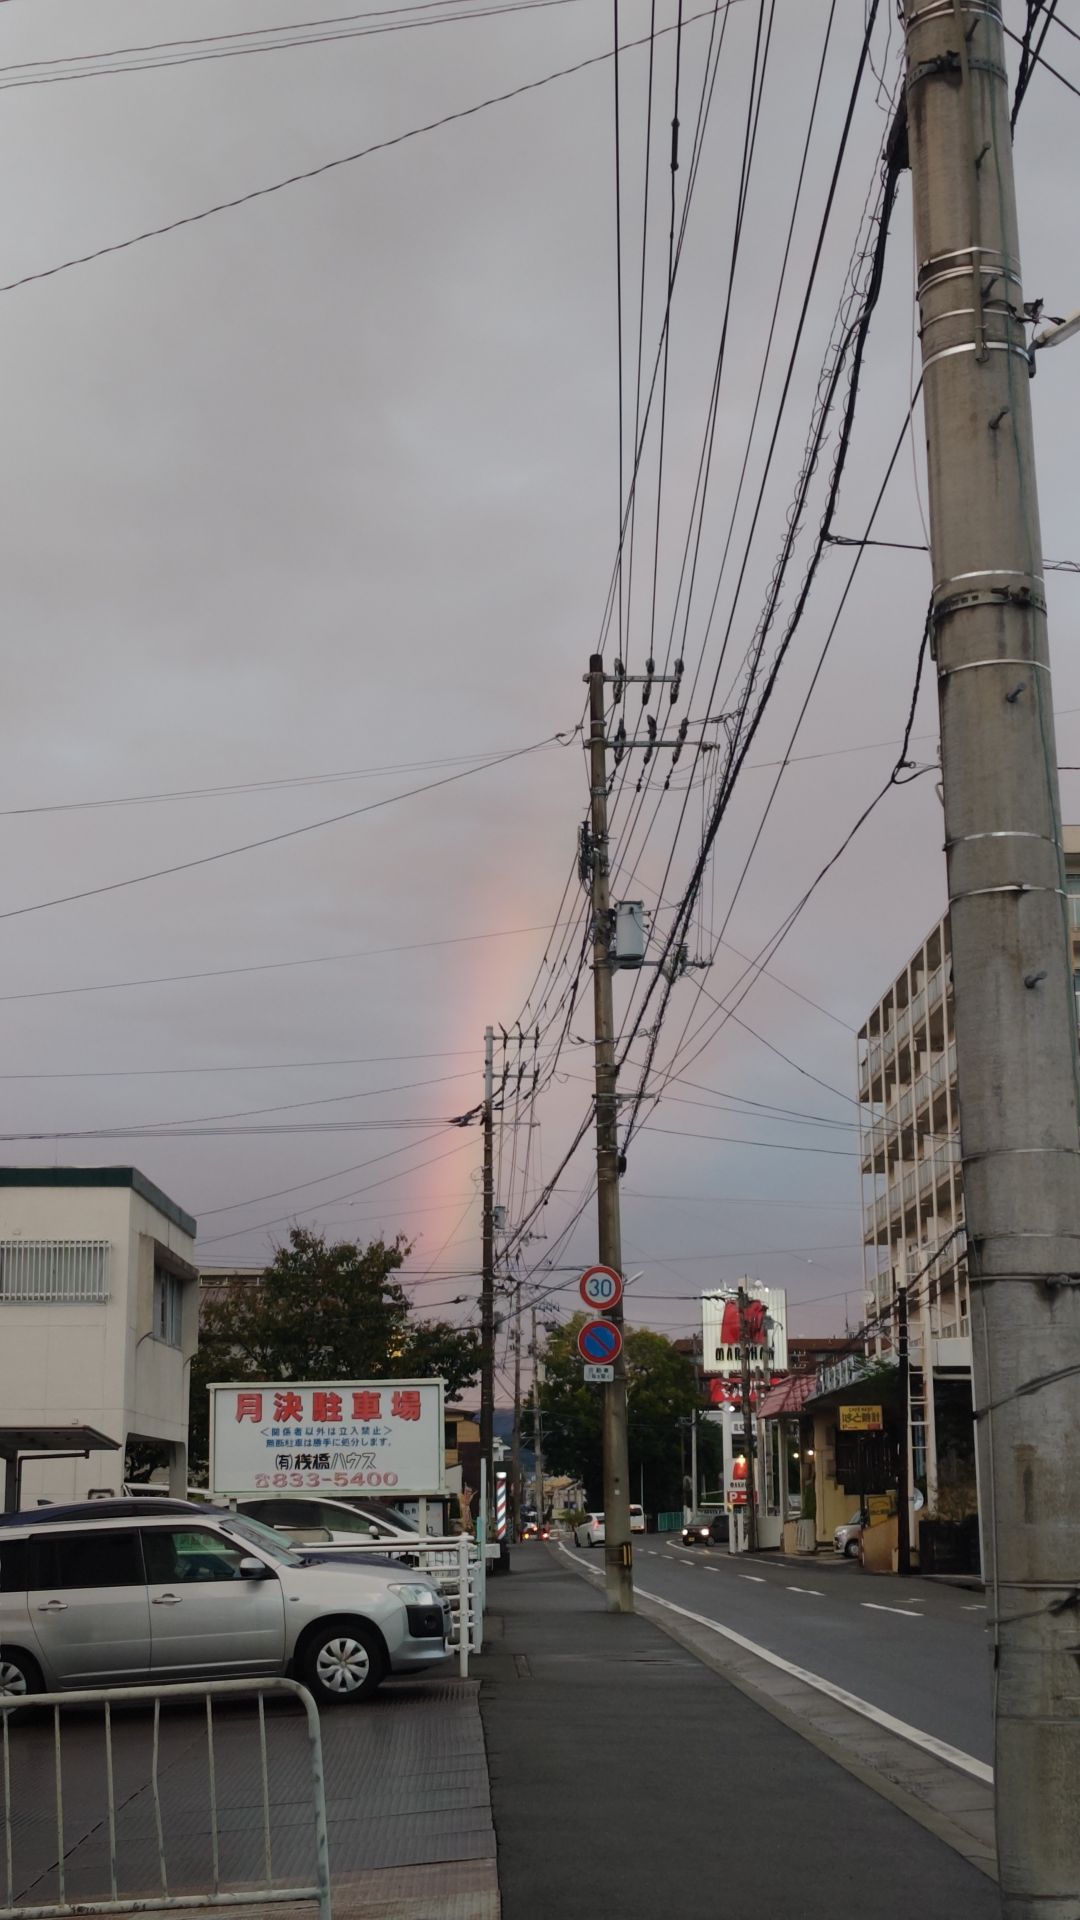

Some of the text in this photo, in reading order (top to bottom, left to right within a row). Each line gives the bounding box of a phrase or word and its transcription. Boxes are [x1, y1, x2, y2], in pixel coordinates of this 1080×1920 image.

[589, 1279, 612, 1296] 30
[235, 1391, 422, 1423] 月決駐車場
